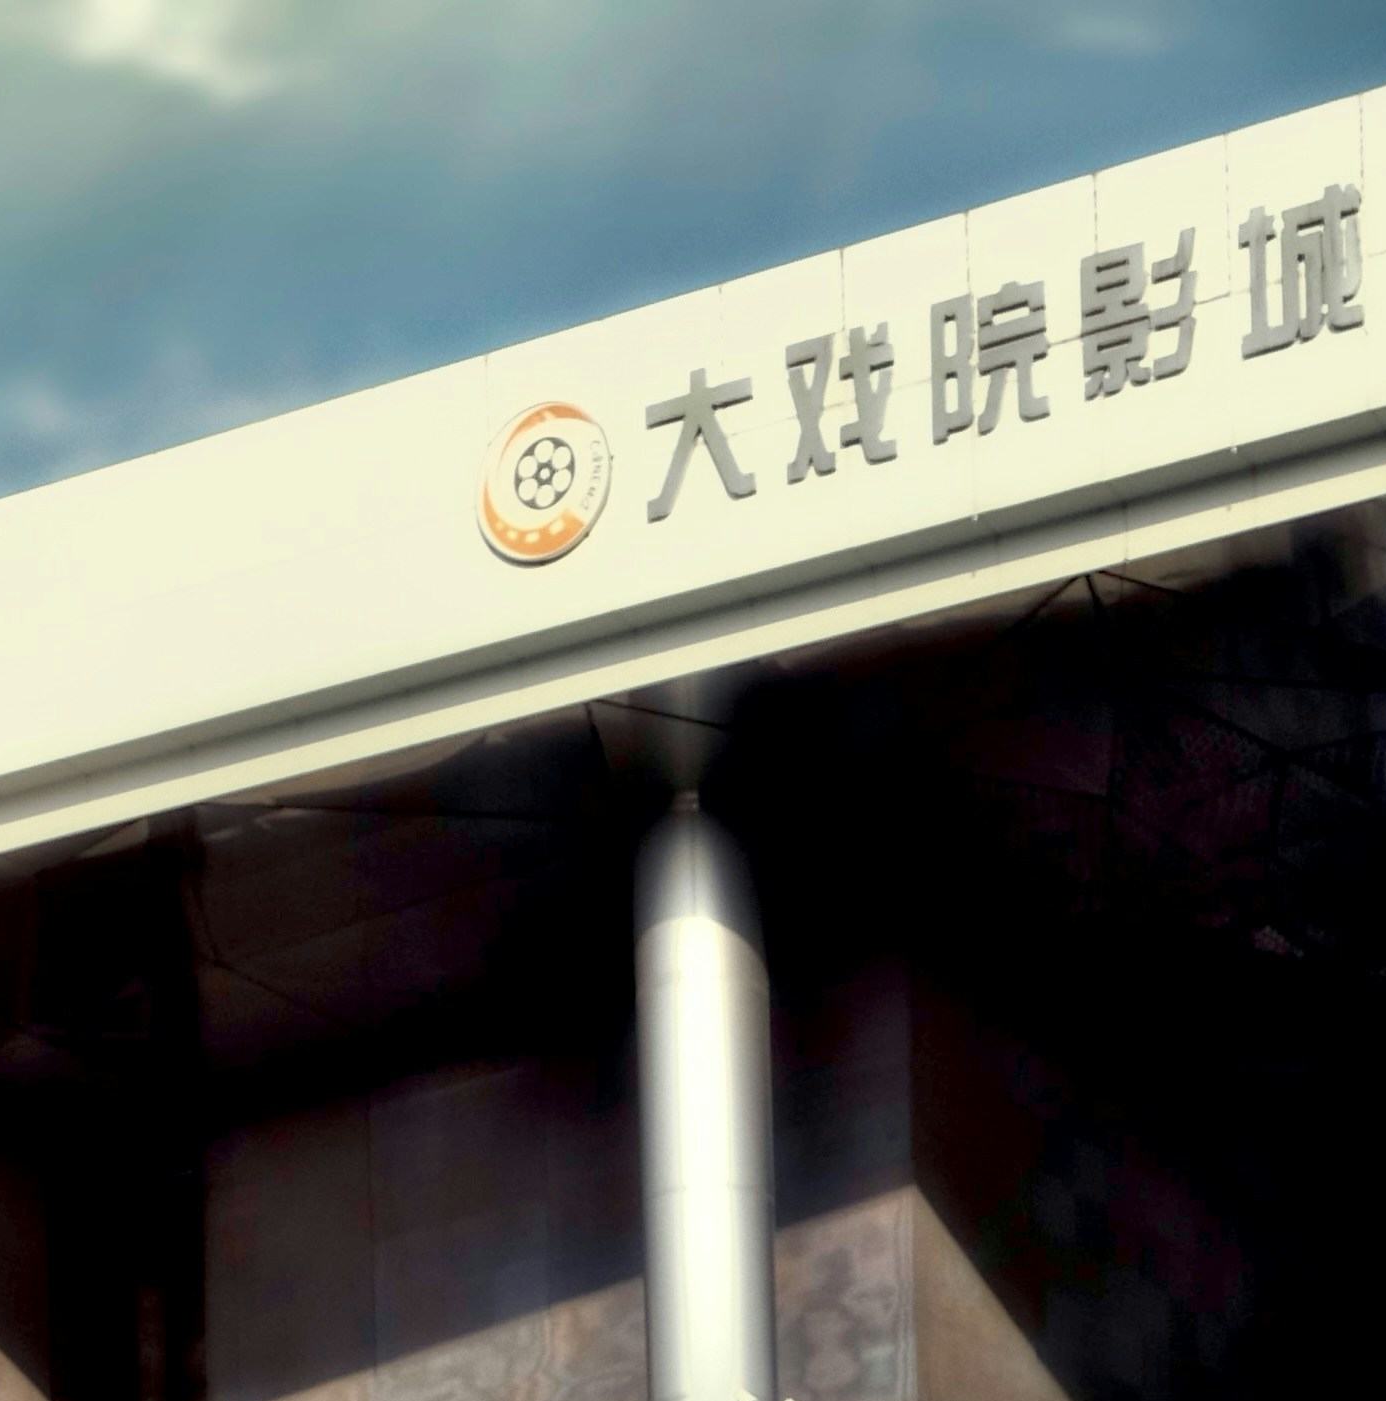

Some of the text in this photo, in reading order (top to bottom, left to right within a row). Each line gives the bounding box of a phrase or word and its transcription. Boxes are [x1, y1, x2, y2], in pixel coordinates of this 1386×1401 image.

[644, 182, 1366, 523] 大戏院影城
